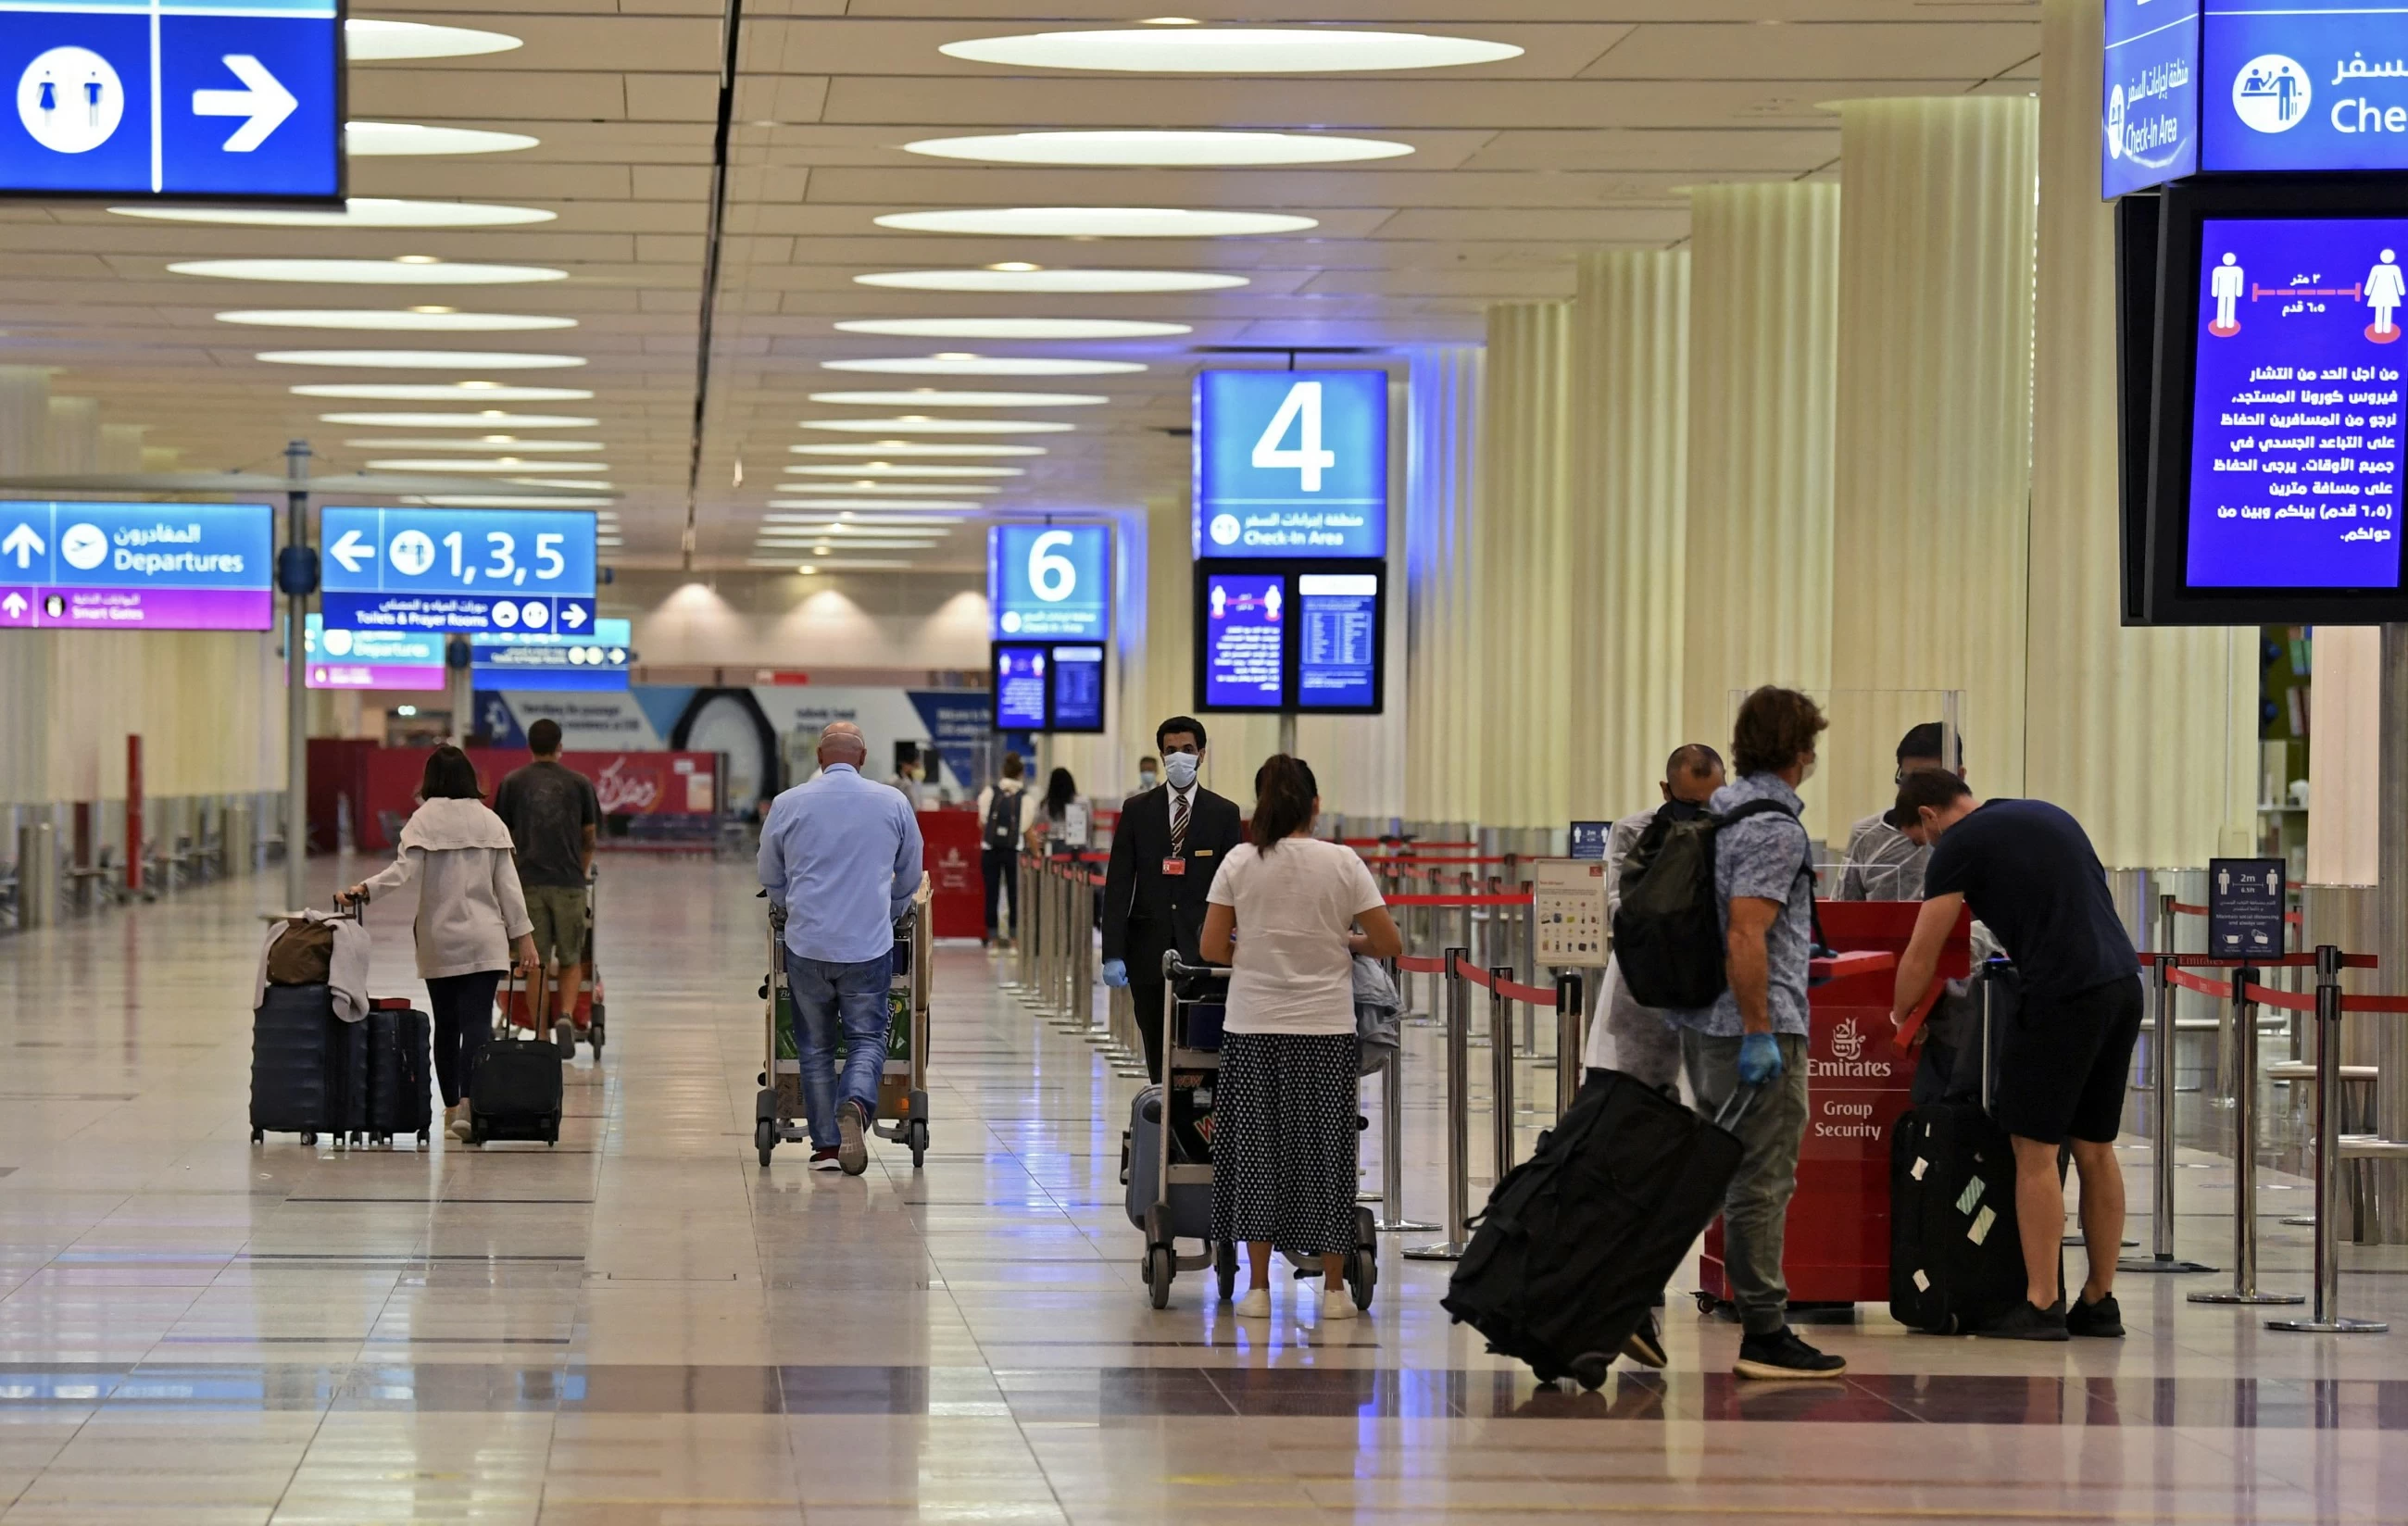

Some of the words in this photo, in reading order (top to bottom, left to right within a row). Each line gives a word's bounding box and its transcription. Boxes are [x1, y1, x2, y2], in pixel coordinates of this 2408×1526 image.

[2168, 57, 2189, 88] منطقة
[2126, 70, 2147, 110] السفر
[2126, 118, 2158, 156] Check-In
[2159, 114, 2177, 145] Area
[2289, 274, 2310, 286] متر
[2281, 300, 2303, 317] قدم
[2250, 366, 2292, 382] انتشار
[2298, 369, 2316, 381] من
[2321, 368, 2347, 379] الحد
[2379, 369, 2399, 381] من
[2301, 391, 2343, 405] كورونا
[2349, 391, 2397, 405] فيروس
[2221, 414, 2264, 425] الحفاظ
[2270, 414, 2339, 428] المسافرين
[2345, 415, 2364, 427] من
[2369, 413, 2396, 428] نرجو
[1251, 382, 1336, 492] 4
[2230, 436, 2254, 452] في
[2259, 436, 2314, 452] الجسدي
[2319, 436, 2362, 450] التباعد
[2367, 436, 2394, 449] على
[2214, 459, 2257, 470] الحفاظ
[2263, 462, 2296, 473] يرجى
[2359, 462, 2394, 473] جميع
[2269, 482, 2307, 496] مترين
[2313, 482, 2360, 494] مسافة
[2365, 482, 2392, 495] على
[2218, 506, 2237, 518] من
[2241, 506, 2270, 519] وبين
[2275, 505, 2314, 519] بينكم
[114, 522, 201, 546] المغادرون
[1244, 530, 1306, 546] Check-In
[1308, 531, 1344, 546] Area
[2340, 528, 2390, 542] حولكم.
[114, 548, 245, 576] Departures
[1028, 530, 1076, 602] 6
[356, 610, 395, 625] Toilets
[396, 611, 408, 625] &
[408, 612, 446, 628] Prayer
[447, 613, 488, 628] Rooms
[2240, 874, 2255, 882] 2m
[1807, 1058, 1892, 1077] Emirates
[1823, 1100, 1874, 1119] Group
[1814, 1121, 1882, 1141] Security
